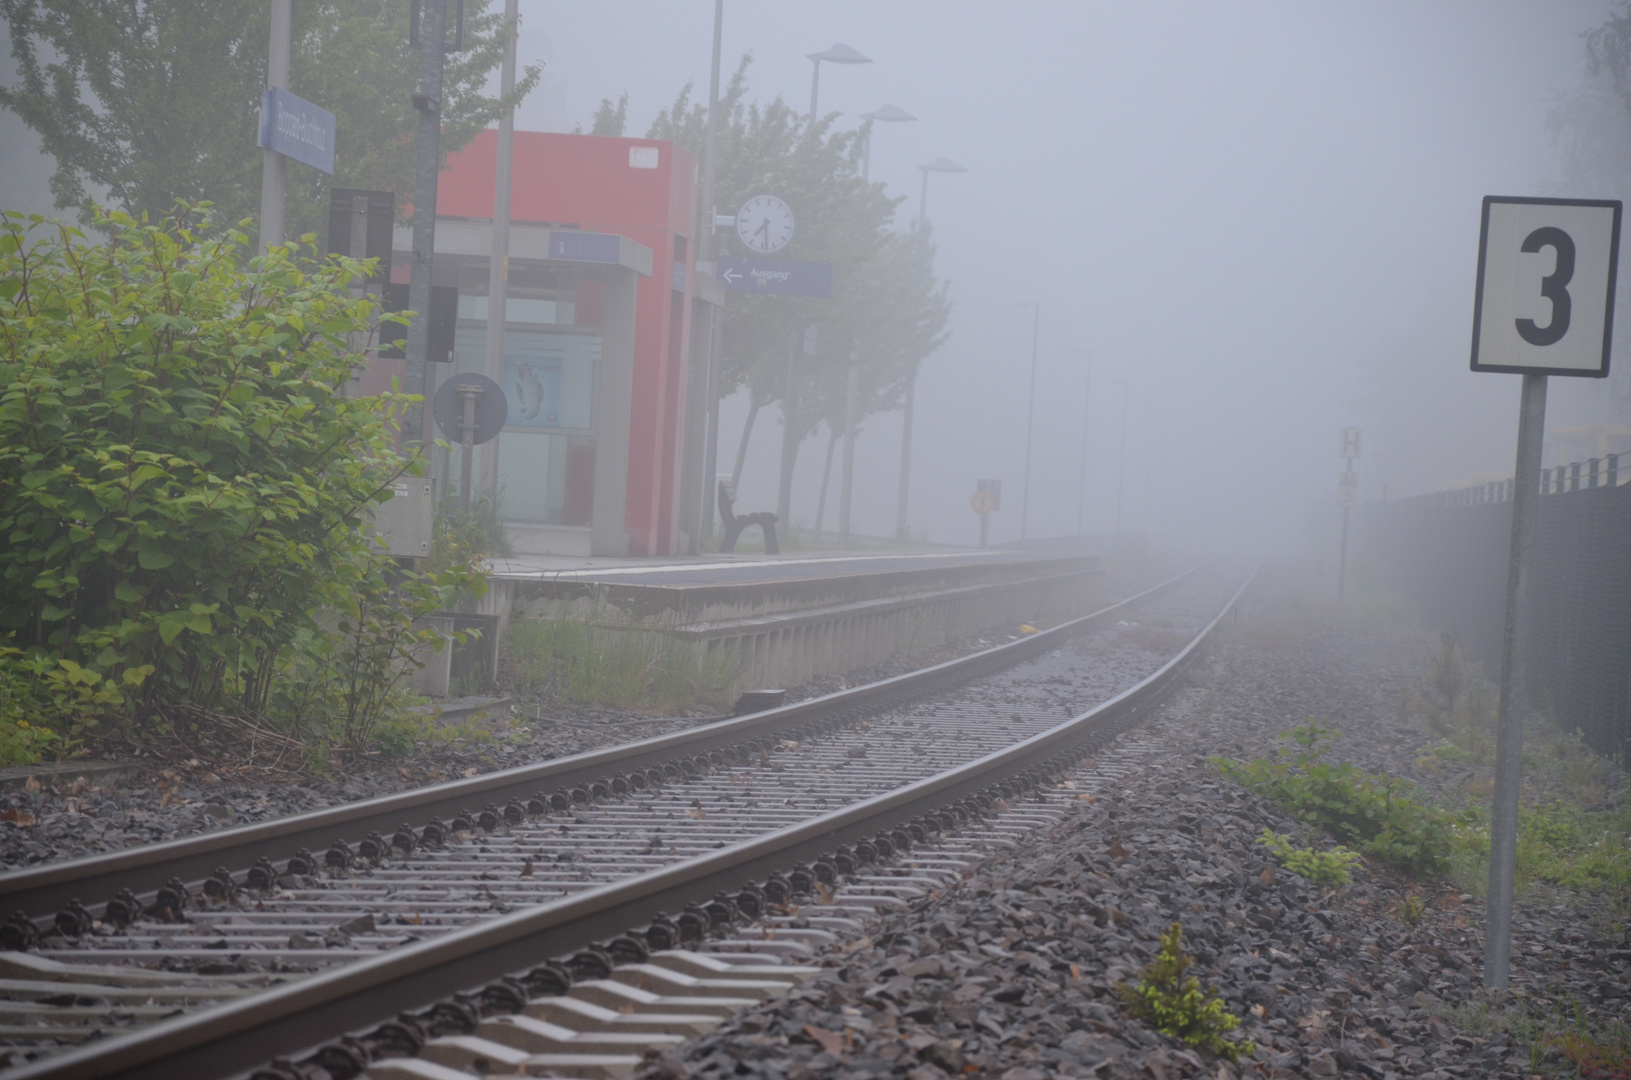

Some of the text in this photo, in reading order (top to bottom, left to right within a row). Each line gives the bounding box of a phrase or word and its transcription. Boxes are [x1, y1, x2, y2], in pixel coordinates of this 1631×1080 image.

[750, 267, 788, 281] Ausgang
[1514, 226, 1577, 347] 3
[1343, 430, 1360, 455] H
